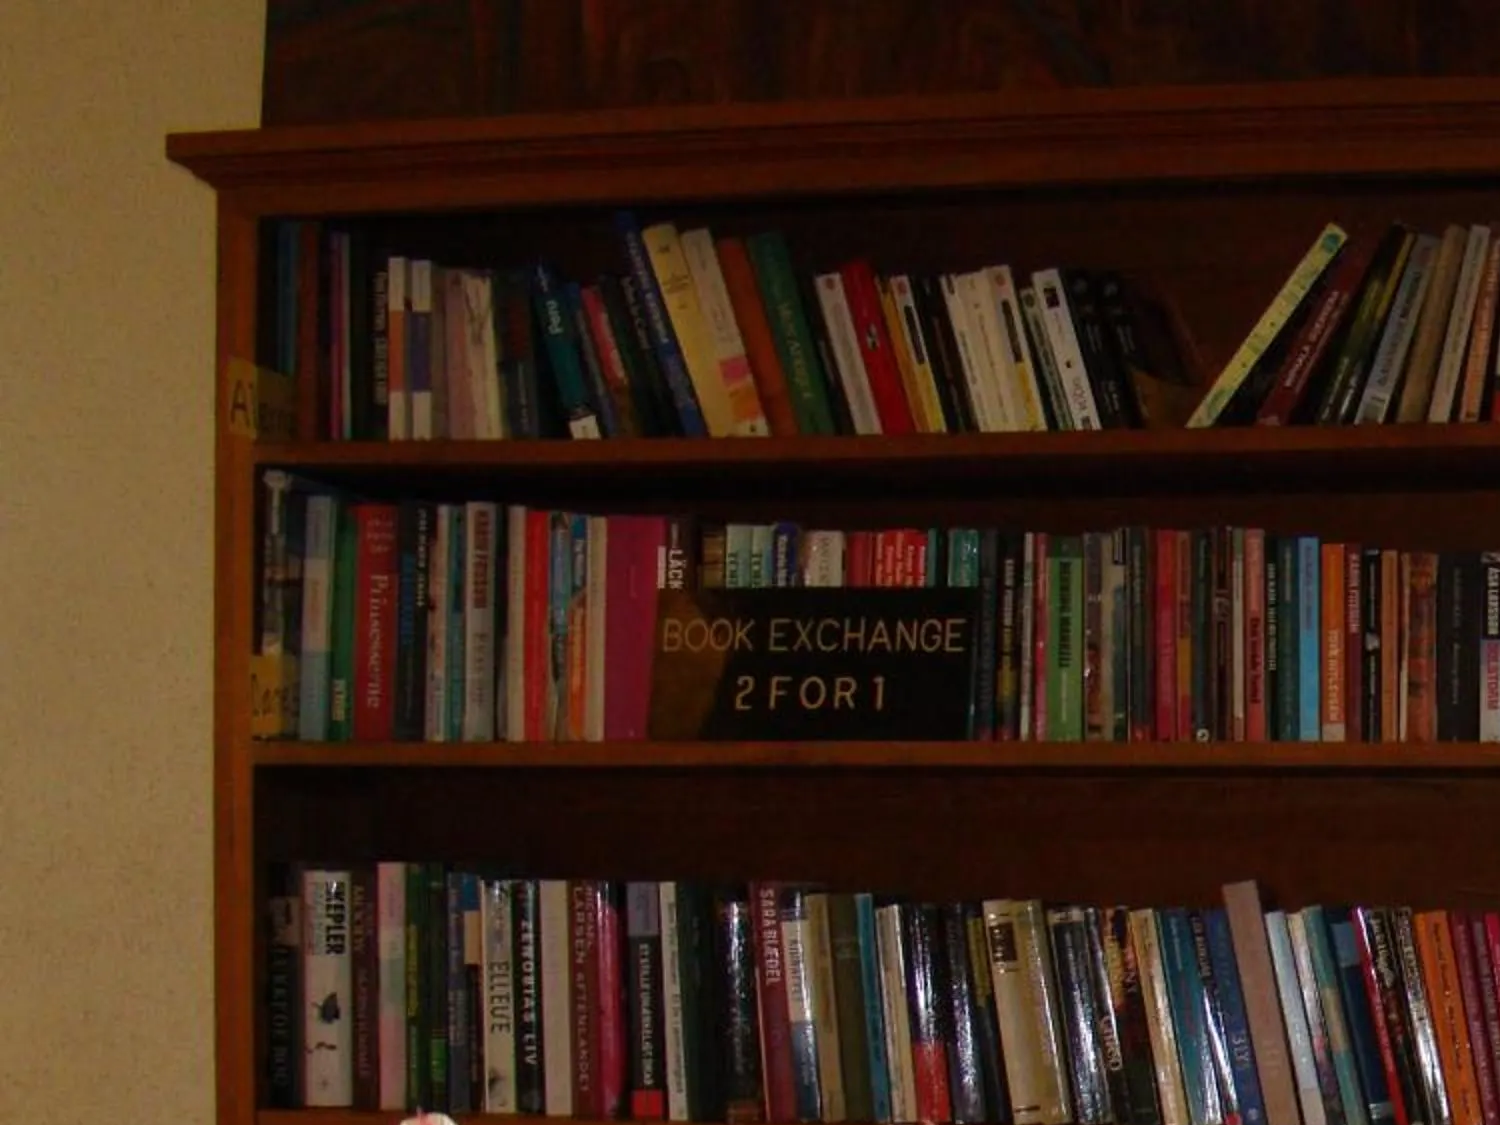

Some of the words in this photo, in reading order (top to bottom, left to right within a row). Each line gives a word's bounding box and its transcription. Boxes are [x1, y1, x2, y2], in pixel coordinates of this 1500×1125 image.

[662, 617, 755, 653] BOOK
[768, 617, 968, 653] EXCHANGE
[734, 675, 755, 712] 2
[768, 675, 860, 712] FOR
[871, 675, 887, 712] 1
[326, 892, 348, 956] KEPLER
[523, 1032, 539, 1066] LIV
